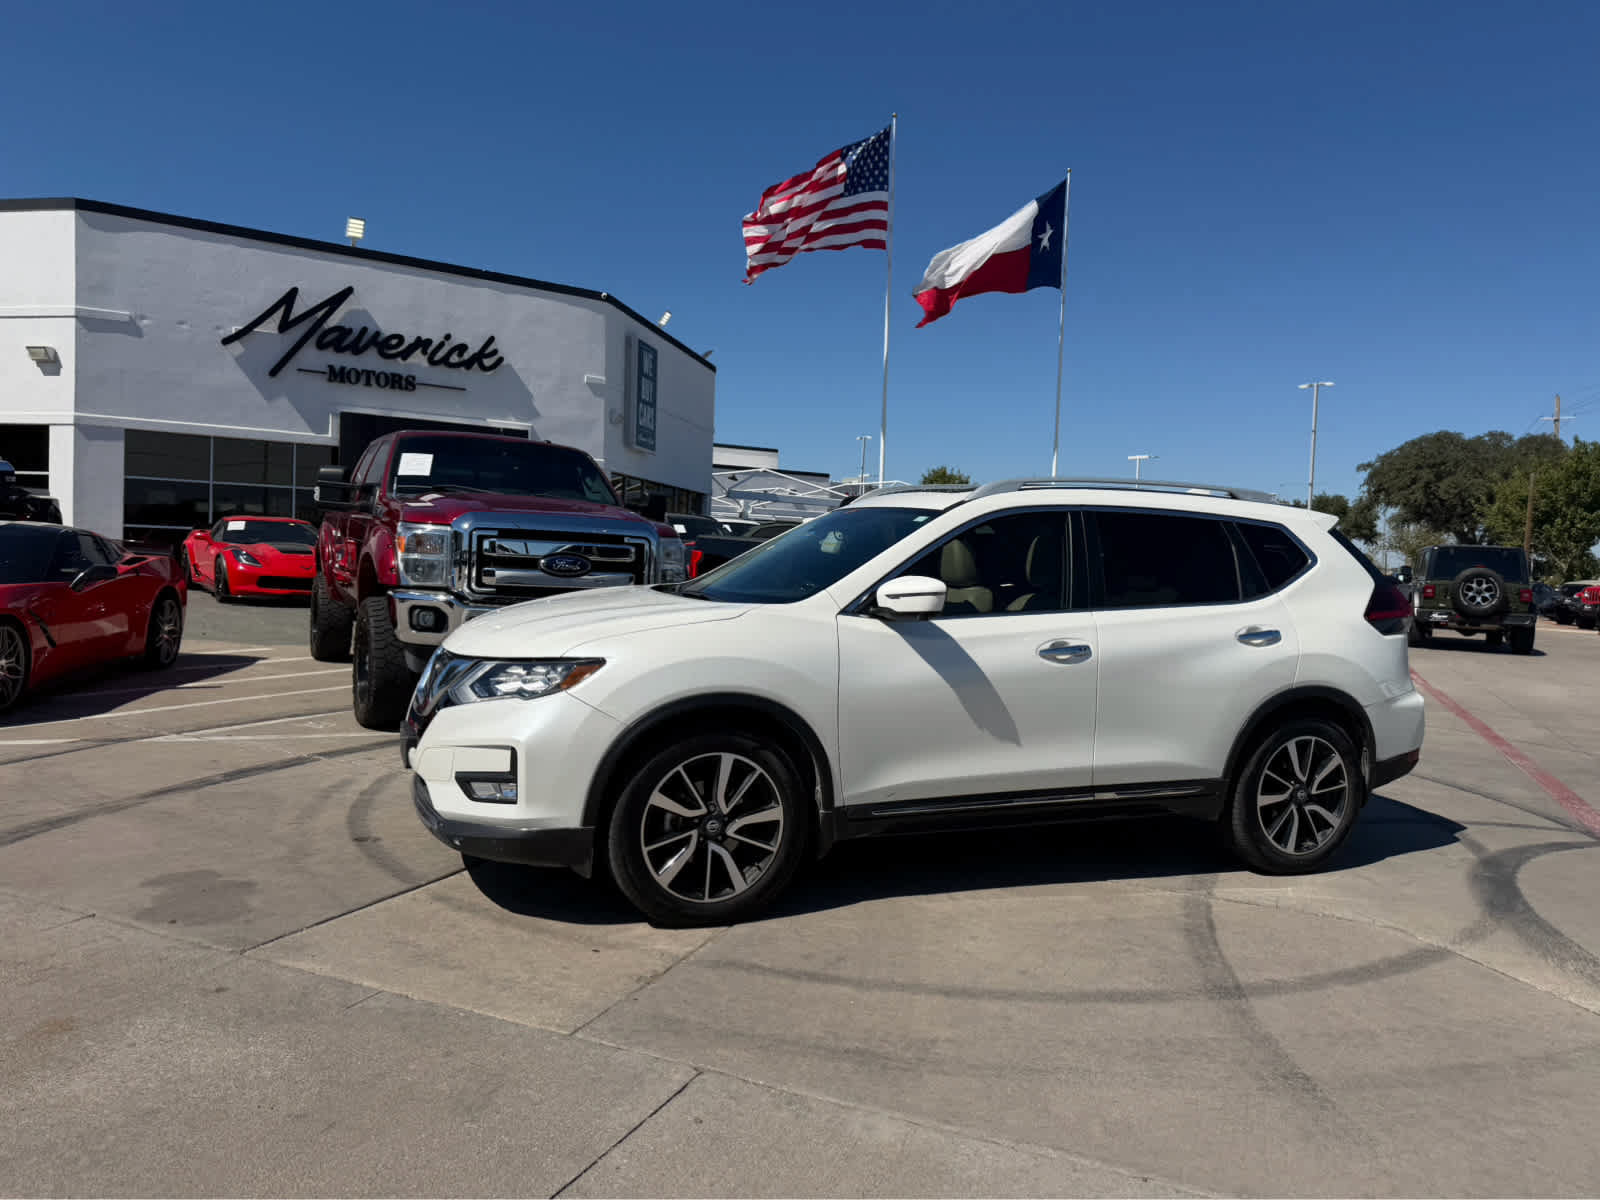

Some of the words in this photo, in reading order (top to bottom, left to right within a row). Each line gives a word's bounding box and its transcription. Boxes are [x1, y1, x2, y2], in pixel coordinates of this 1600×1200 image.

[221, 285, 505, 377] Maverick
[327, 364, 417, 392] MOTORS
[552, 558, 582, 571] Ford
